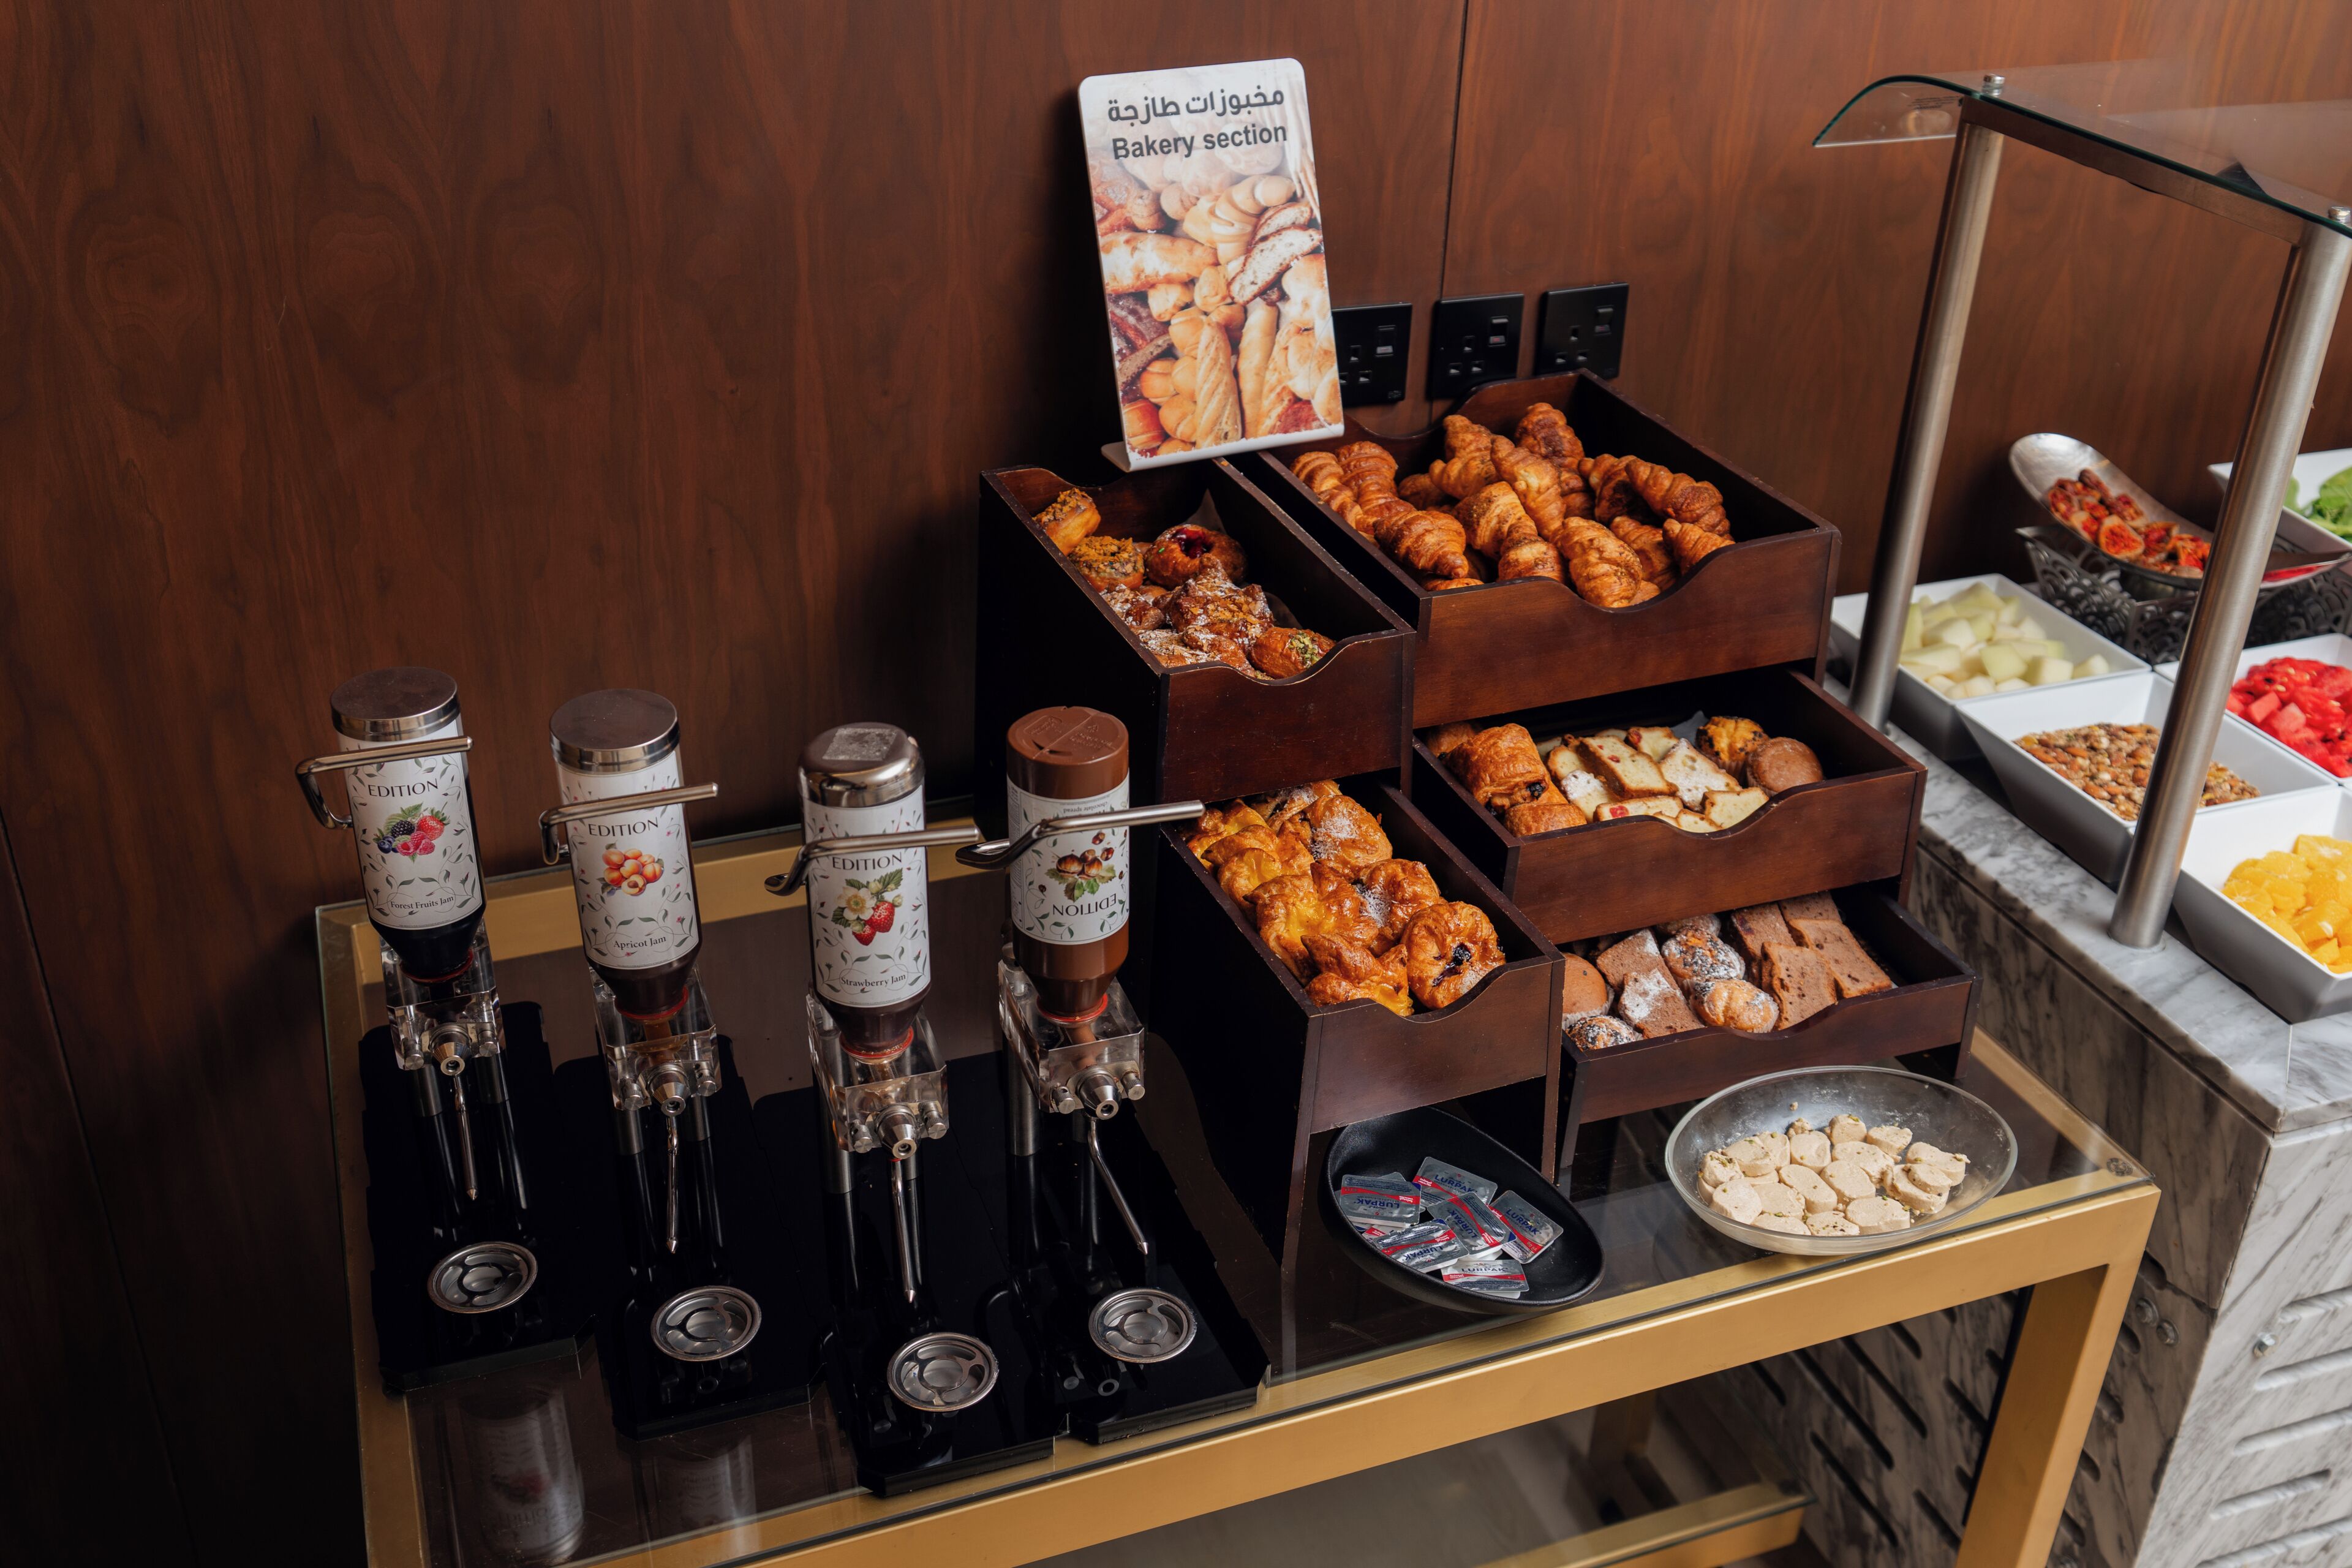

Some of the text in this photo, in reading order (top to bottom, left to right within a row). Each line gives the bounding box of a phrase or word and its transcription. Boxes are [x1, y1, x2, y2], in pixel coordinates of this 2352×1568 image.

[1107, 85, 1284, 127] مخبوزات طازجة
[1112, 123, 1287, 160] Bakery section
[368, 778, 438, 797] EDITION
[1084, 801, 1107, 811] chocolate
[588, 816, 658, 837] EDITION
[832, 851, 902, 871] EDITION
[440, 896, 454, 905] Jam
[1052, 893, 1117, 916] EDITION
[613, 936, 666, 951] Apricot Jam
[841, 974, 906, 987] Strawberry Jam
[1357, 1198, 1400, 1208] LURPAK
[1449, 1210, 1478, 1238] LURPAK
[1506, 1208, 1540, 1235] LURPAK
[1403, 1246, 1444, 1261] LURPAK
